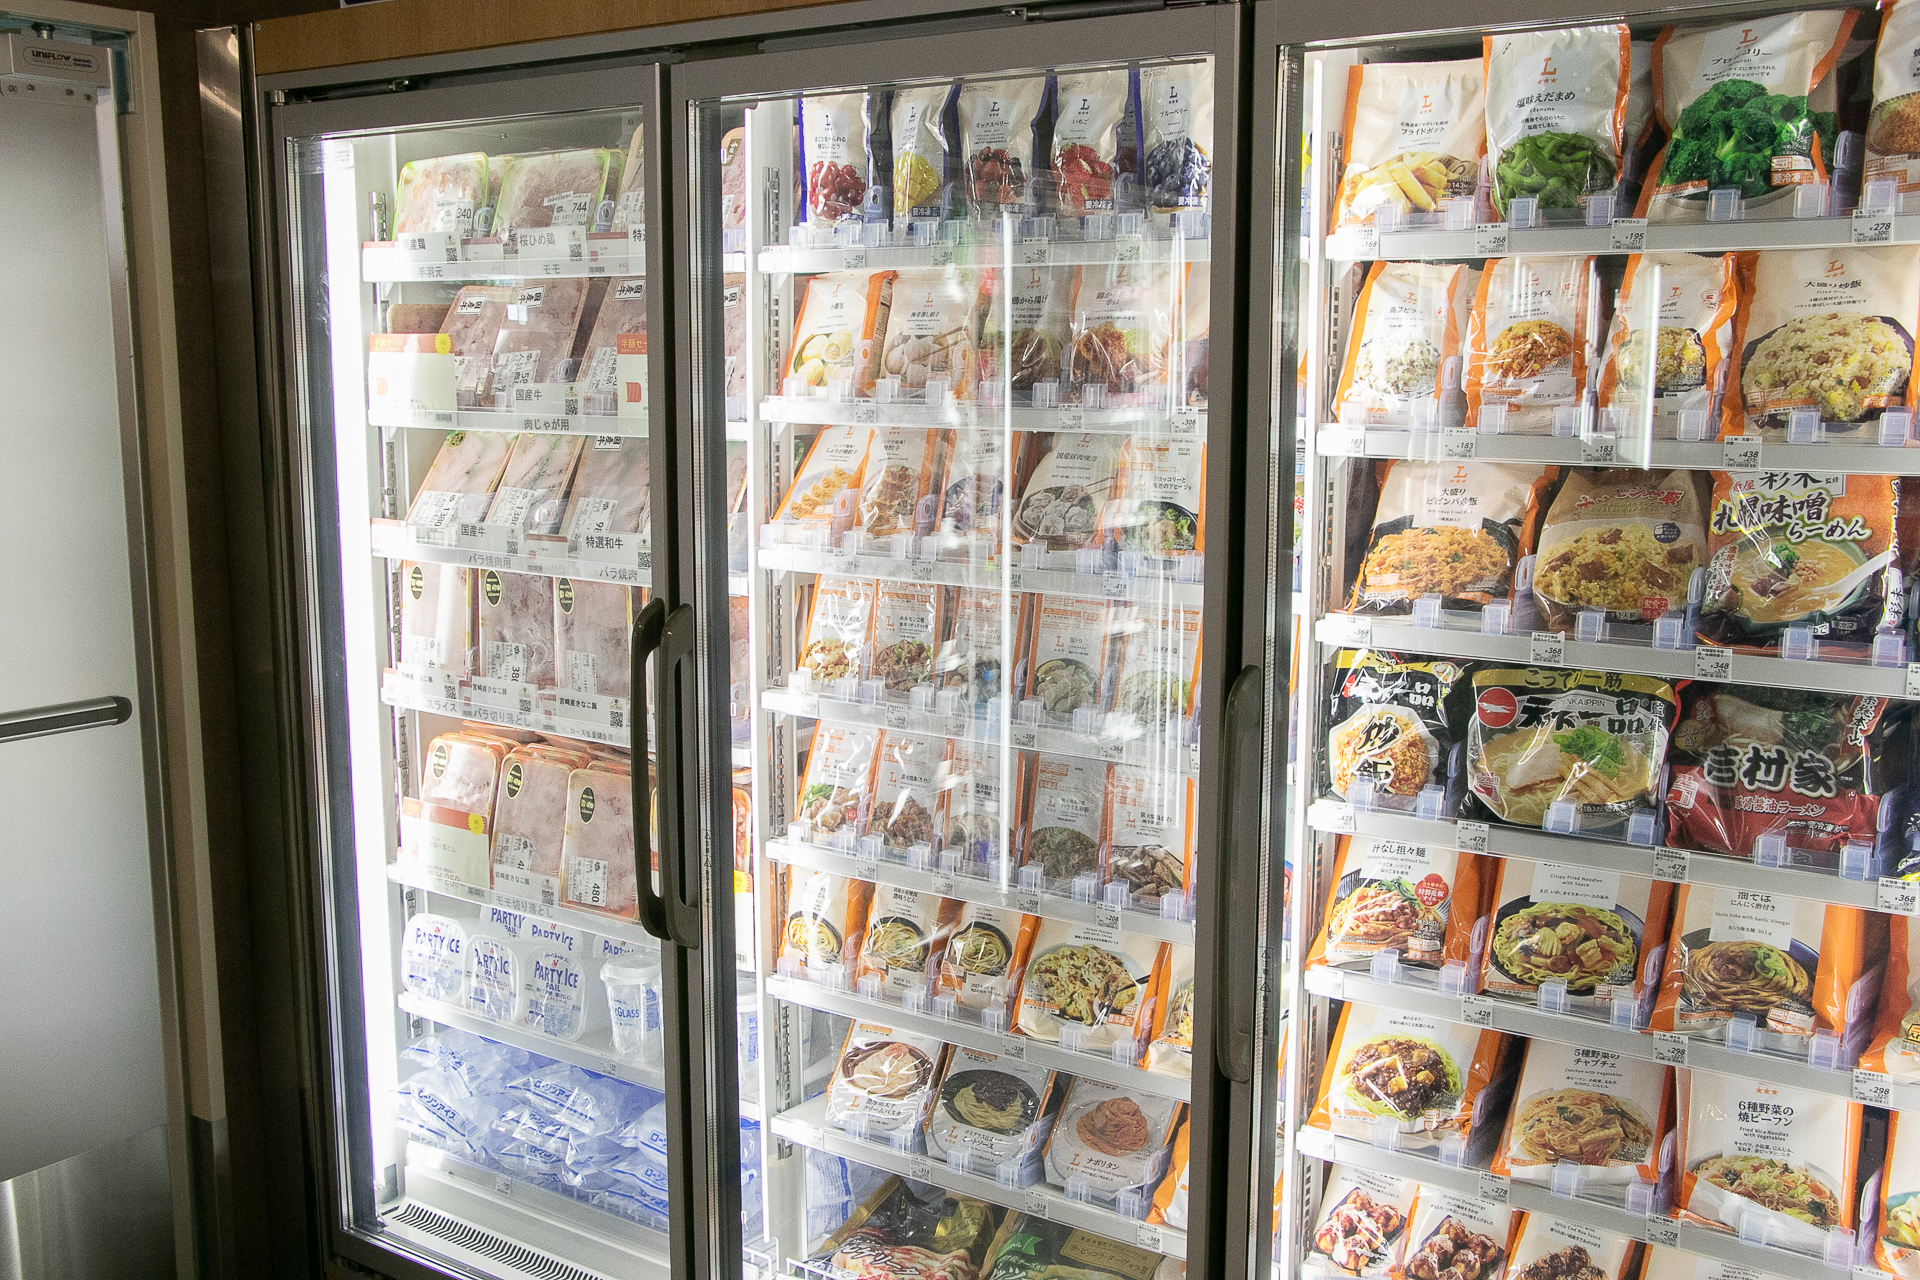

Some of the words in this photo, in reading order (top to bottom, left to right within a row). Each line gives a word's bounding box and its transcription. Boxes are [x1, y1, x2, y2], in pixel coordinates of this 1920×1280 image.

[1739, 29, 1758, 44] L
[31, 49, 71, 61] UNIFLOW
[1540, 57, 1558, 76] L
[1170, 86, 1177, 98] L
[1080, 99, 1090, 110] L
[1422, 95, 1432, 108] L
[1516, 91, 1575, 108] 塩味えだまめ
[991, 101, 999, 112] L
[1159, 108, 1188, 117] ブルーベリー
[976, 121, 1009, 129] ミックスベリー
[1400, 126, 1446, 136] フライドポテト
[456, 207, 472, 219] 340
[571, 202, 588, 213] 744
[519, 233, 556, 246] 桜ひめ鶏
[418, 266, 443, 278] 手羽元
[543, 264, 560, 275] モモ
[1828, 260, 1845, 273] L
[1031, 269, 1040, 283] L
[1804, 278, 1862, 290] 大盛り炒飯
[1408, 292, 1418, 301] L
[1671, 286, 1682, 297] L
[925, 293, 933, 303] L
[516, 389, 542, 400] 国産牛
[524, 418, 570, 431] 肉じゃが用
[846, 427, 853, 436] L
[1080, 433, 1092, 443] L
[1454, 466, 1468, 478] L
[1825, 476, 1839, 484] 監修
[1440, 487, 1466, 497] 大盛り
[1714, 492, 1828, 532] 札幌味噌
[461, 524, 486, 537] 国産牛
[1788, 516, 1866, 540] らーめん
[586, 535, 624, 549] 特選和牛
[468, 554, 511, 569] バラ焼肉用
[599, 567, 638, 581] バラ焼肉
[886, 616, 894, 626] L
[1056, 636, 1064, 647] L
[1524, 667, 1623, 691] こってり一筋
[559, 697, 598, 711] 宮崎産きなこ豚
[473, 709, 531, 727] バラ切り落とし
[1516, 696, 1645, 736] 天下一品
[824, 758, 830, 767] L
[1703, 743, 1838, 798] 吉村家
[890, 772, 896, 782] L
[1048, 796, 1055, 808] L
[1127, 811, 1136, 823] L
[1372, 843, 1426, 858] 汁なし担々麺
[1894, 894, 1916, 903] ¥368
[496, 895, 554, 918] モモ切り落とし
[1730, 899, 1777, 912] にんにく酢付き
[535, 960, 563, 982] PARTY
[564, 969, 578, 988] ICE
[546, 983, 561, 992] PAIL
[1574, 1048, 1620, 1061] 5種野菜の
[1573, 1058, 1617, 1069] チャプチェ
[851, 1096, 859, 1108] L
[862, 1105, 902, 1117] クリームパスタ
[1738, 1100, 1794, 1117] 6種野菜の
[1737, 1111, 1793, 1127] 焼ビーフン
[949, 1125, 958, 1139] L
[1069, 1153, 1080, 1167] L
[1086, 1157, 1120, 1171] ナポリタン
